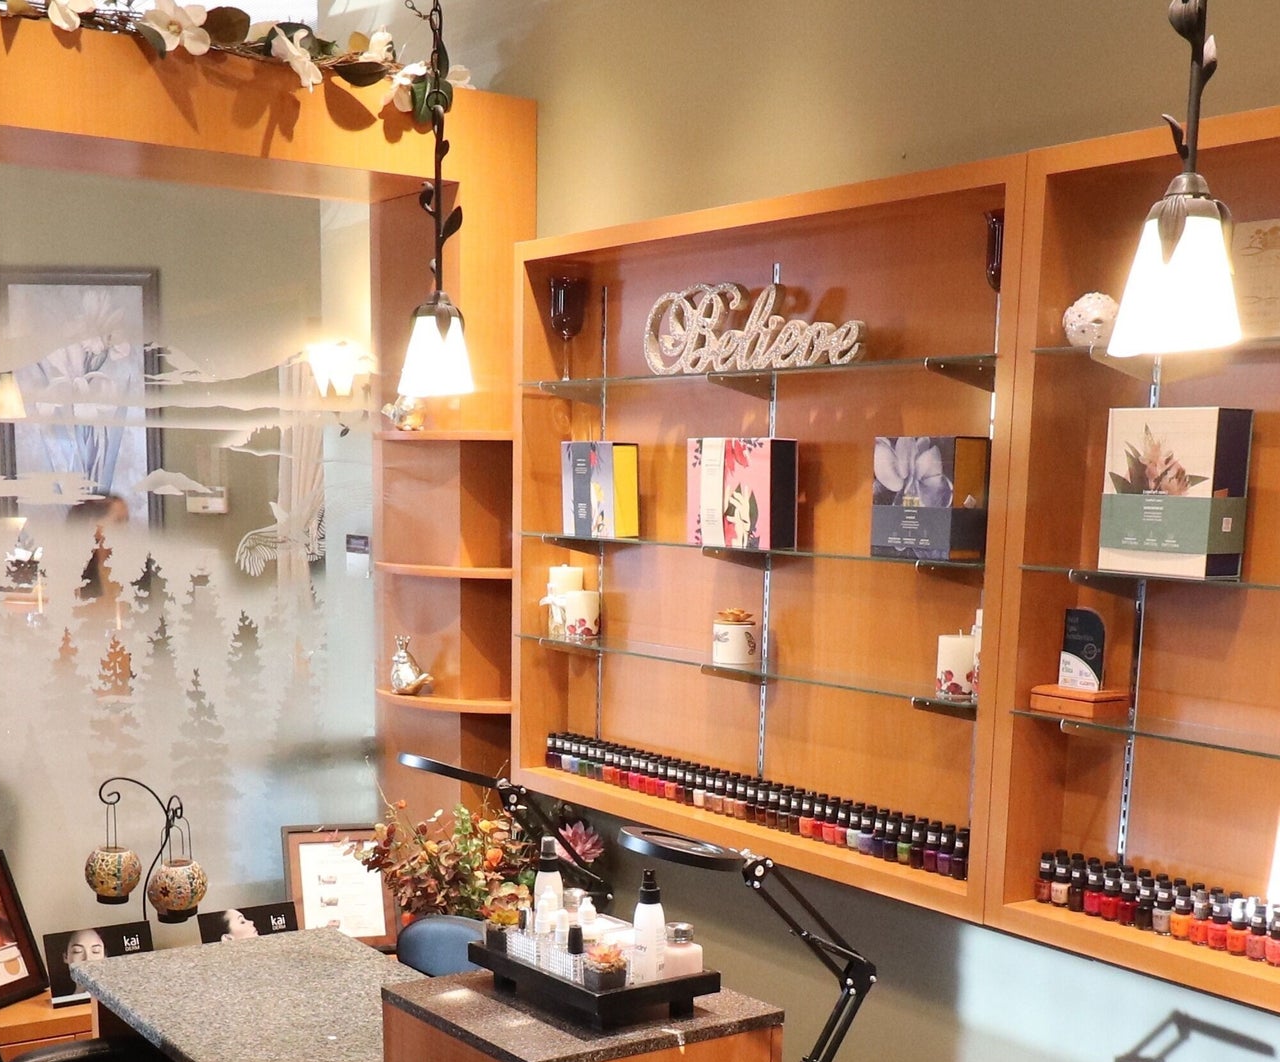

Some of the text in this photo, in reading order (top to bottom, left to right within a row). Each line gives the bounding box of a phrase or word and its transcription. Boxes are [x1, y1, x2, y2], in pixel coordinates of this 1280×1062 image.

[644, 282, 865, 375] Believe
[270, 914, 286, 926] kai
[123, 934, 140, 947] kai
